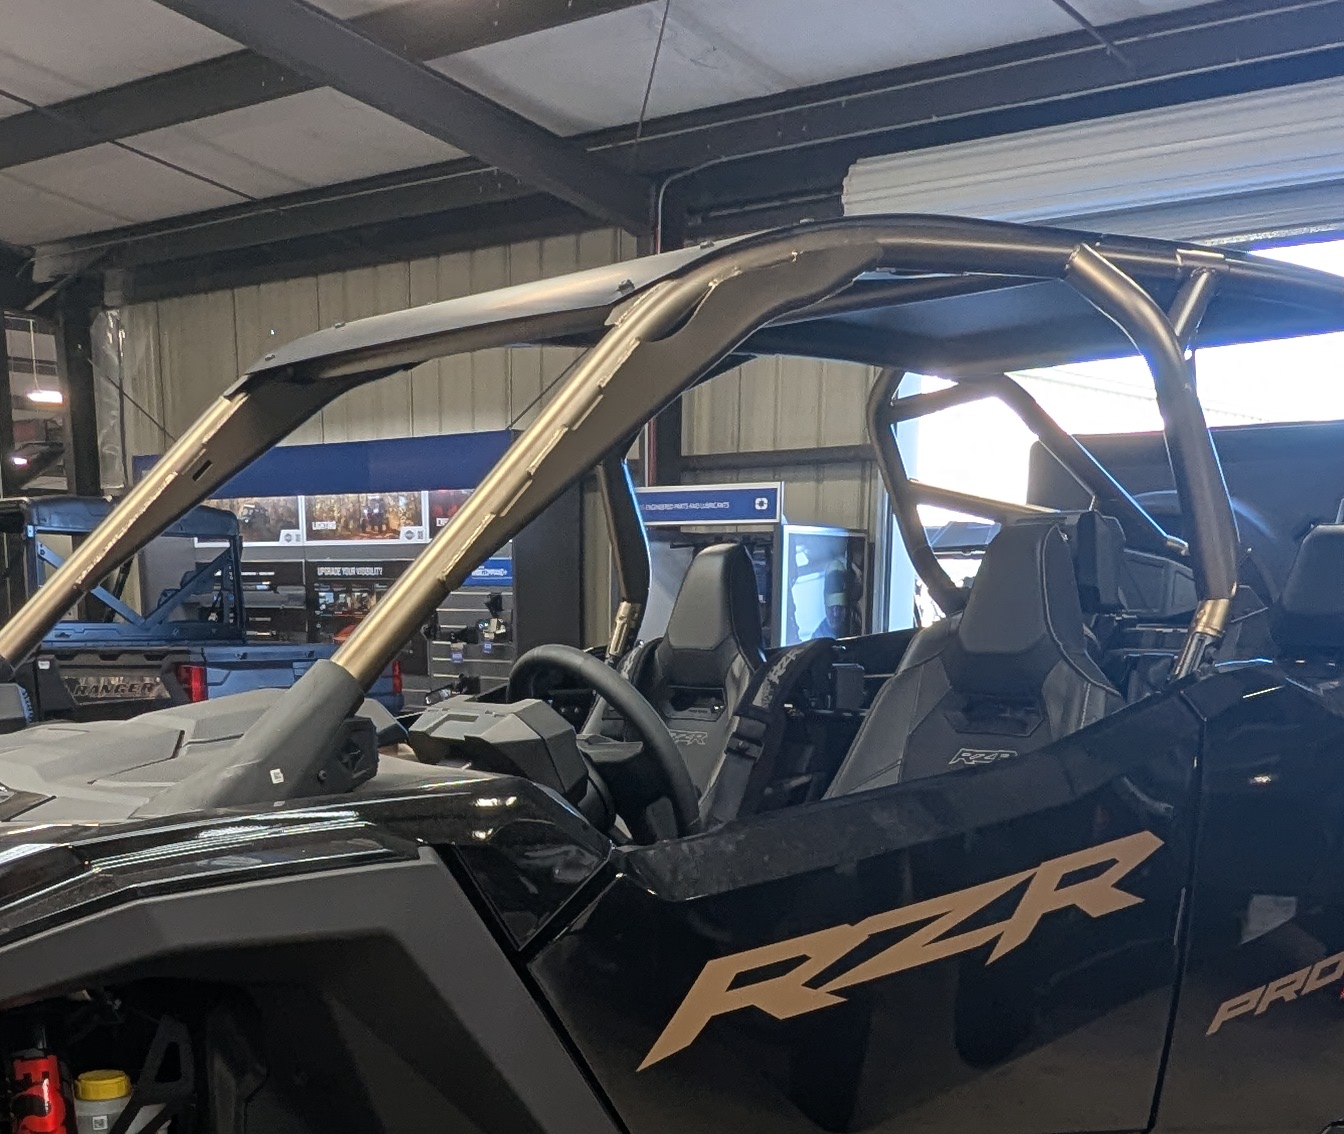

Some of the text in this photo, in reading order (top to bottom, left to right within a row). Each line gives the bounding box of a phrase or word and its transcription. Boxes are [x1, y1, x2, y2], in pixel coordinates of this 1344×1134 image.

[76, 682, 154, 696] RANGER
[668, 729, 708, 746] ZR
[638, 830, 1164, 1072] RZR
